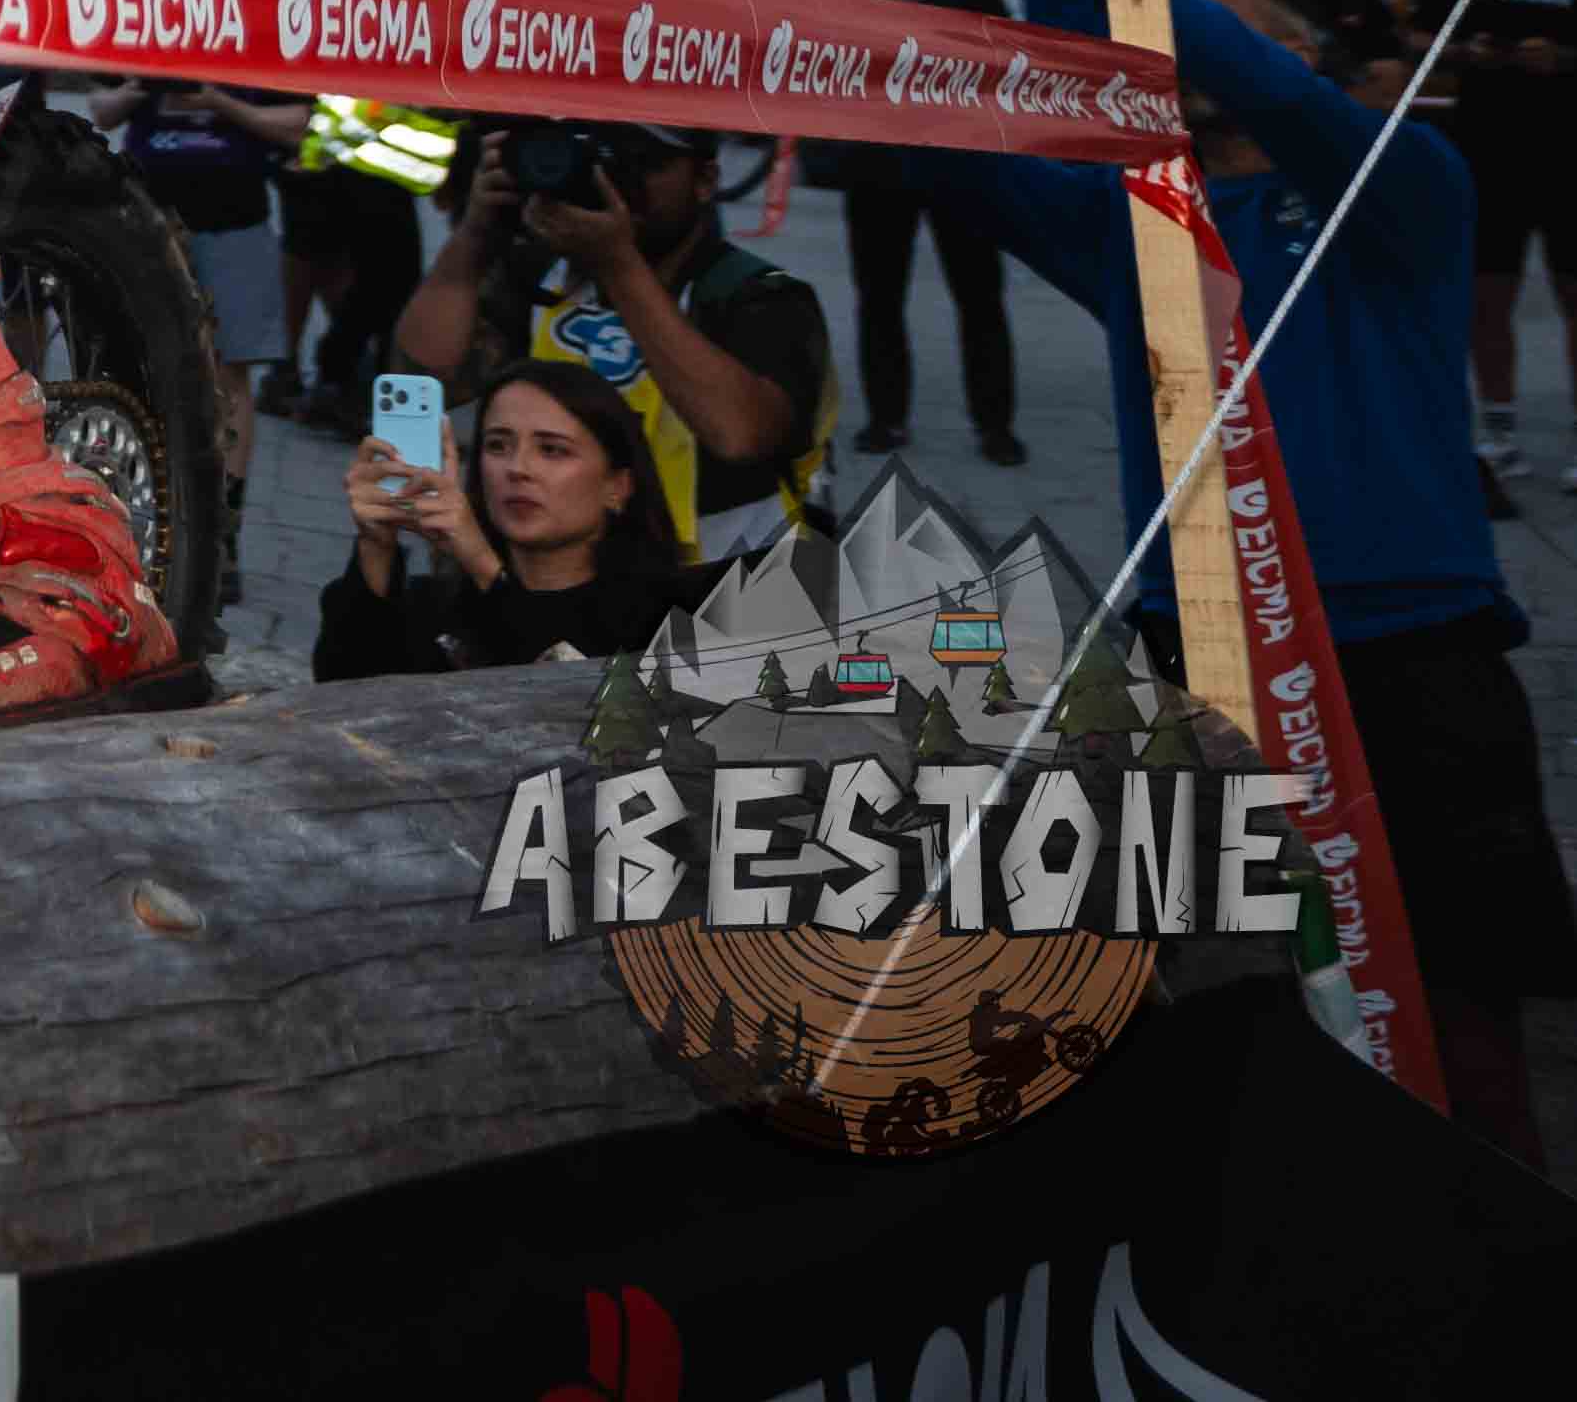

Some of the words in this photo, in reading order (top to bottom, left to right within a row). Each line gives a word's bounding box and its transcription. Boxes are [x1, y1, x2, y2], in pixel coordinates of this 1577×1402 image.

[495, 8, 599, 77] EICMA
[651, 24, 743, 88] EICMA
[789, 41, 872, 101] EICMA
[908, 52, 988, 109] EICMA
[1017, 66, 1095, 122] EICMA
[1239, 527, 1294, 646] EICMA
